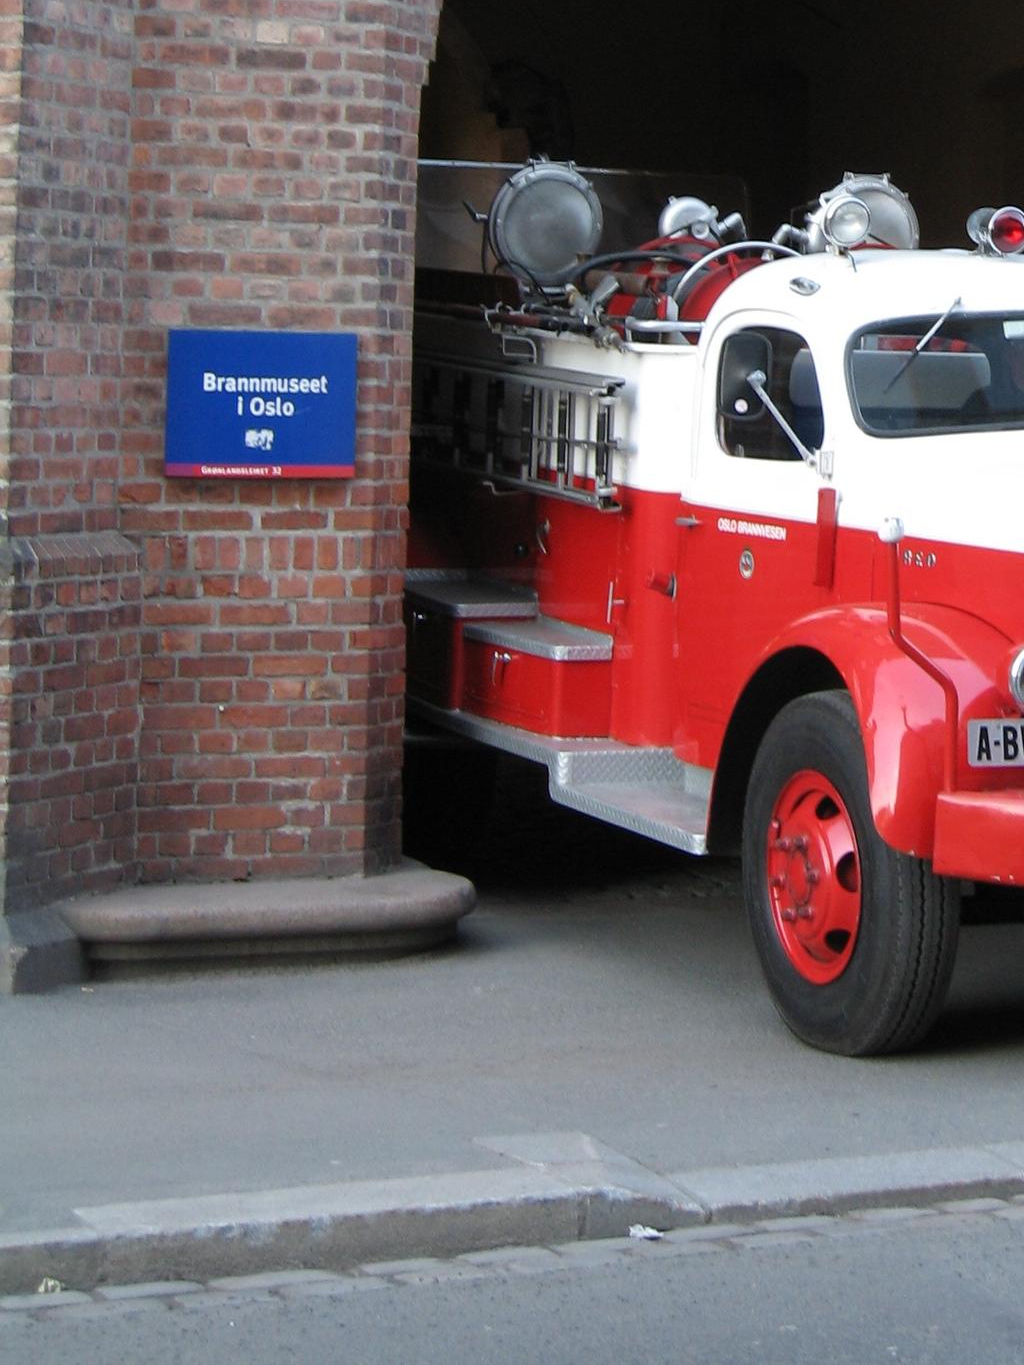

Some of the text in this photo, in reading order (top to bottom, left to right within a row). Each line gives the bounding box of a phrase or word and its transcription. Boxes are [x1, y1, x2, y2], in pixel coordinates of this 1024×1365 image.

[202, 371, 329, 394] Brannmuseet
[236, 395, 295, 417] i Oslo
[272, 465, 282, 477] 32
[717, 517, 738, 535] OSLO
